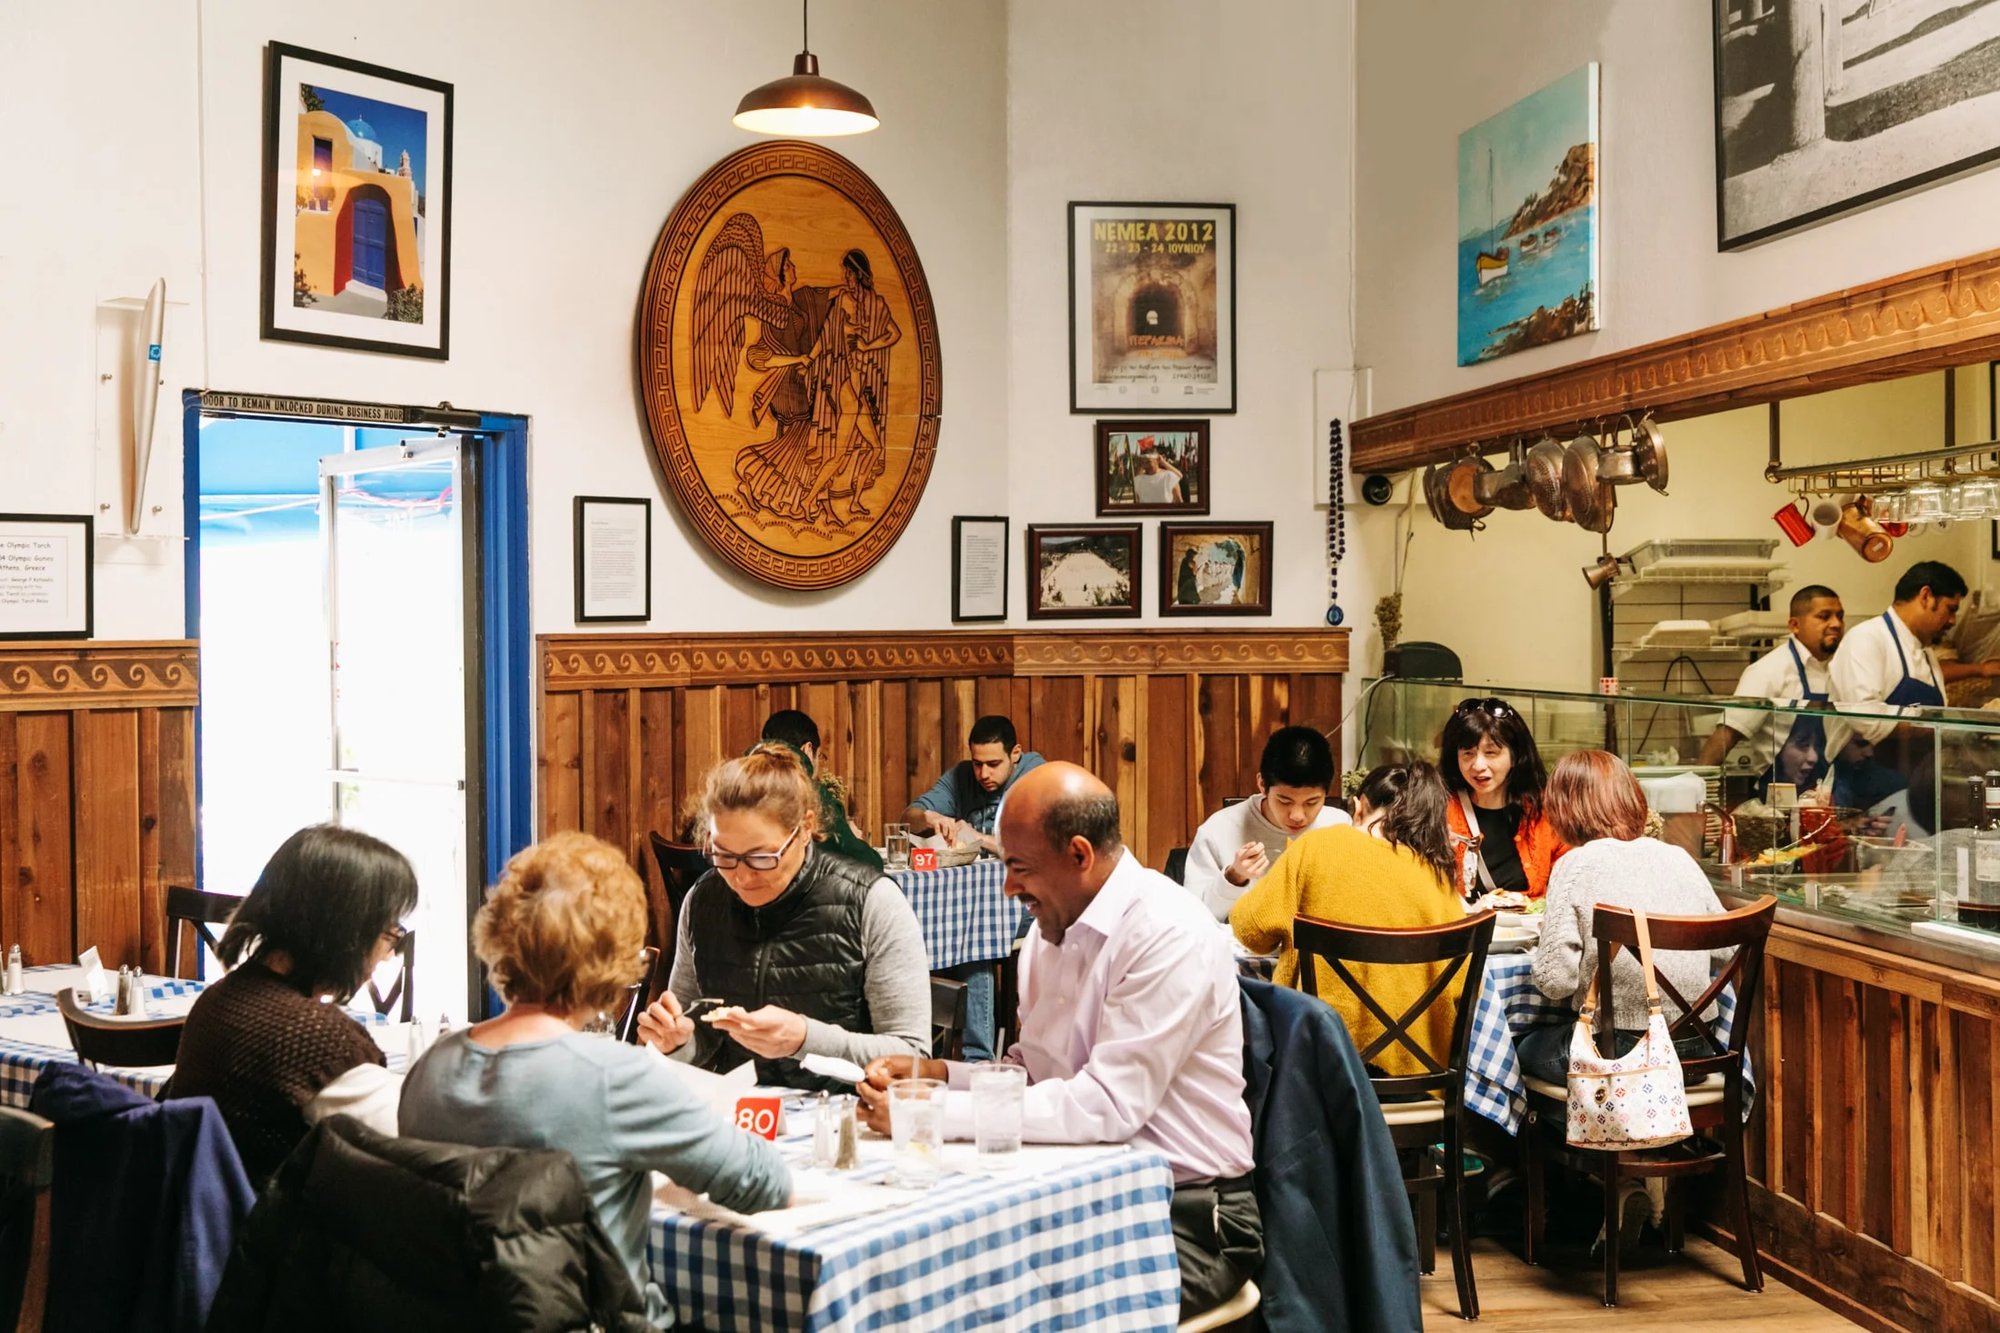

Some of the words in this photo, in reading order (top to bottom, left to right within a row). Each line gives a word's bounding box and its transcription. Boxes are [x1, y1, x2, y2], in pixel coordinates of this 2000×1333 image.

[1094, 222, 1159, 241] NEMEA
[1164, 222, 1213, 241] 2012
[1151, 243, 1164, 254] 24
[203, 395, 224, 407] DOOR
[228, 397, 238, 408] TO
[241, 398, 271, 410] REMAIN
[274, 400, 313, 414] UNLOCKED
[316, 404, 344, 417] DURING
[347, 406, 381, 419] BUSINESS
[915, 853, 934, 866] 97
[736, 1108, 775, 1134] 80
